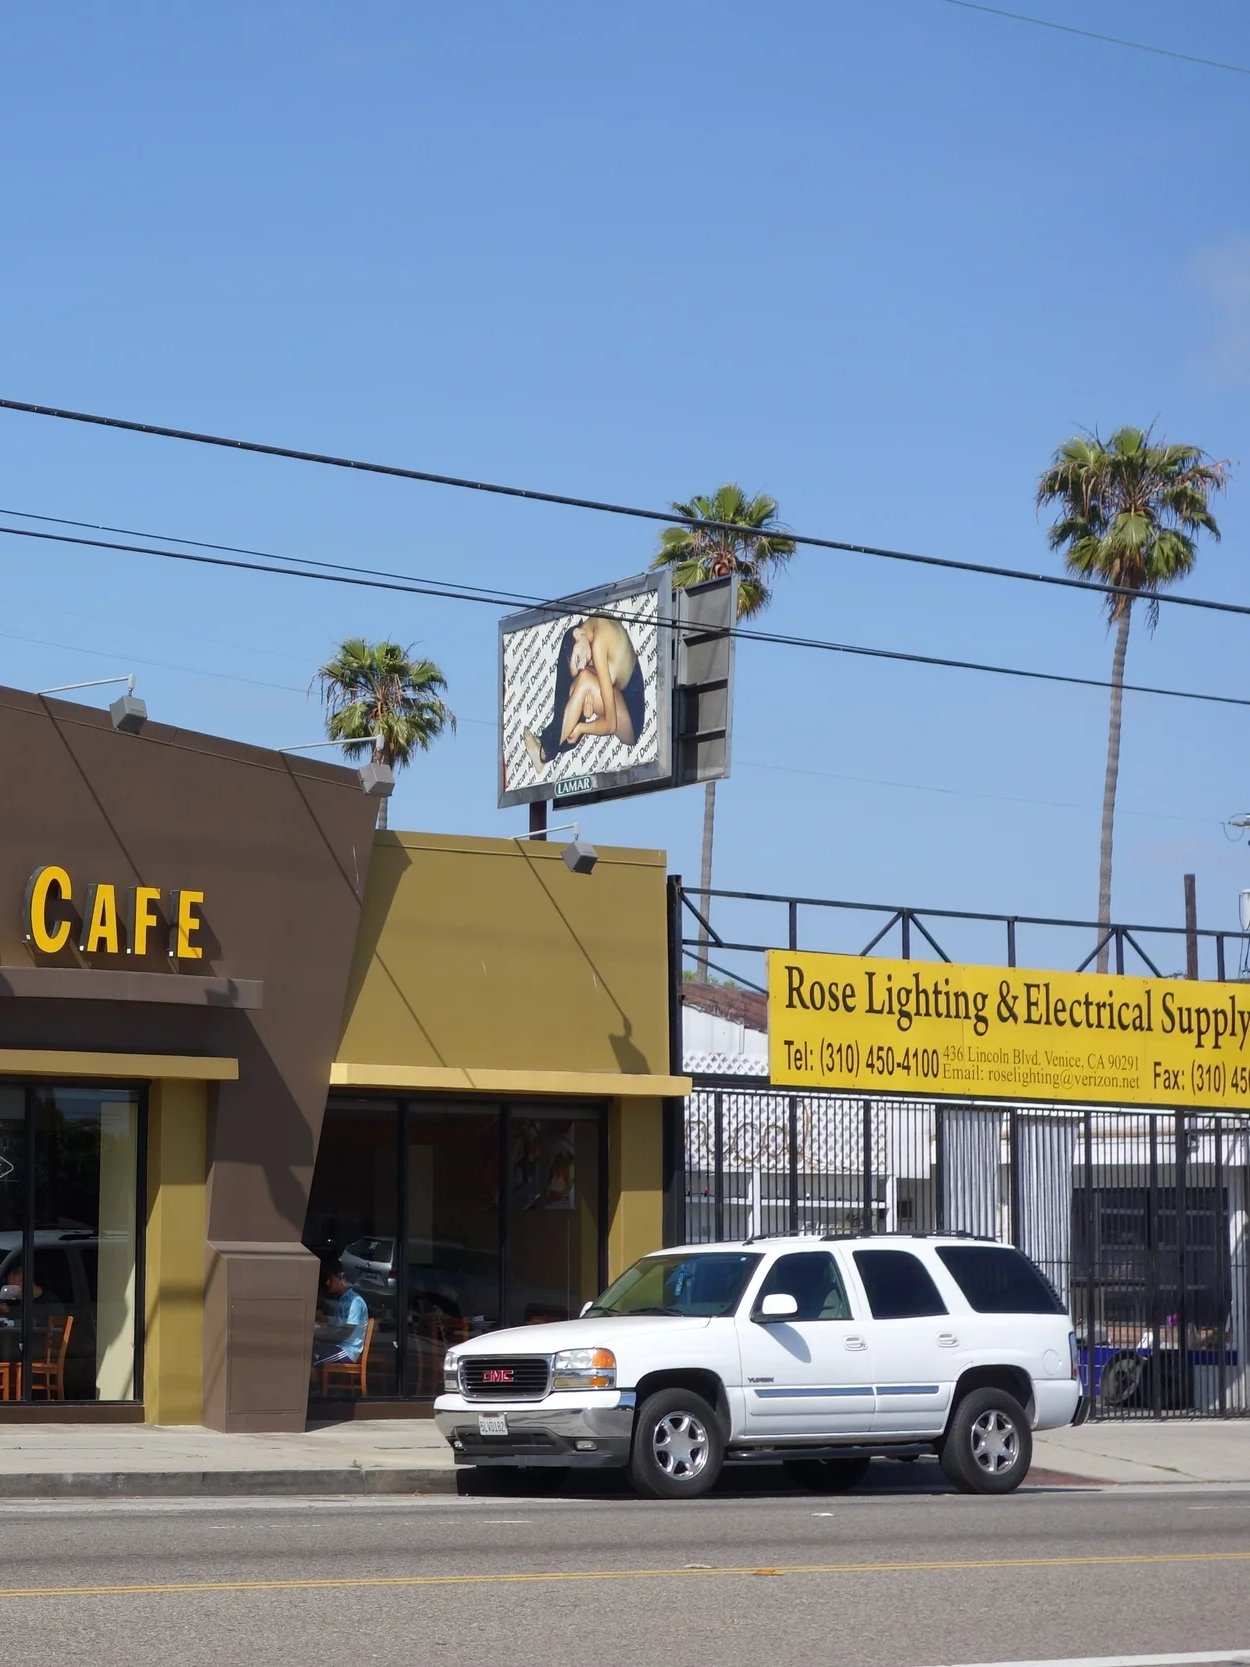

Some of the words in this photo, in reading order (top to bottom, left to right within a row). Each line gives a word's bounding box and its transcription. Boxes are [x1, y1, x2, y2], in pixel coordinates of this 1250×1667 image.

[507, 654, 524, 689] Apparel
[523, 631, 539, 658] Denim
[520, 647, 541, 686] American
[513, 682, 531, 715] Apparel
[530, 659, 547, 685] Denim
[526, 675, 549, 713] American
[537, 687, 554, 713] Denim
[505, 719, 522, 744] Denim
[558, 778, 590, 795] LAMAR
[26, 865, 204, 959] CAFE
[784, 965, 857, 1013] Rose
[864, 971, 989, 1037] Lighting
[996, 980, 1019, 1026] &
[1023, 981, 1154, 1032] Electrical
[1161, 991, 1250, 1052] Supply
[783, 1039, 814, 1071] Tel:
[820, 1037, 860, 1078] (310)
[866, 1044, 940, 1079] 450-4100
[943, 1045, 964, 1062] 436
[967, 1046, 1010, 1064] Lincoln
[1012, 1048, 1041, 1066] Blvd.
[1044, 1050, 1084, 1070] Venice,
[1087, 1053, 1105, 1070] CA
[1108, 1054, 1140, 1072] 90291
[943, 1063, 984, 1081] Email:
[988, 1065, 1140, 1090] roselighting@verizon.net
[1153, 1061, 1185, 1091] Fax:
[1191, 1059, 1227, 1098] (310)
[1230, 1065, 1250, 1095] 45
[482, 1369, 514, 1383] GMC
